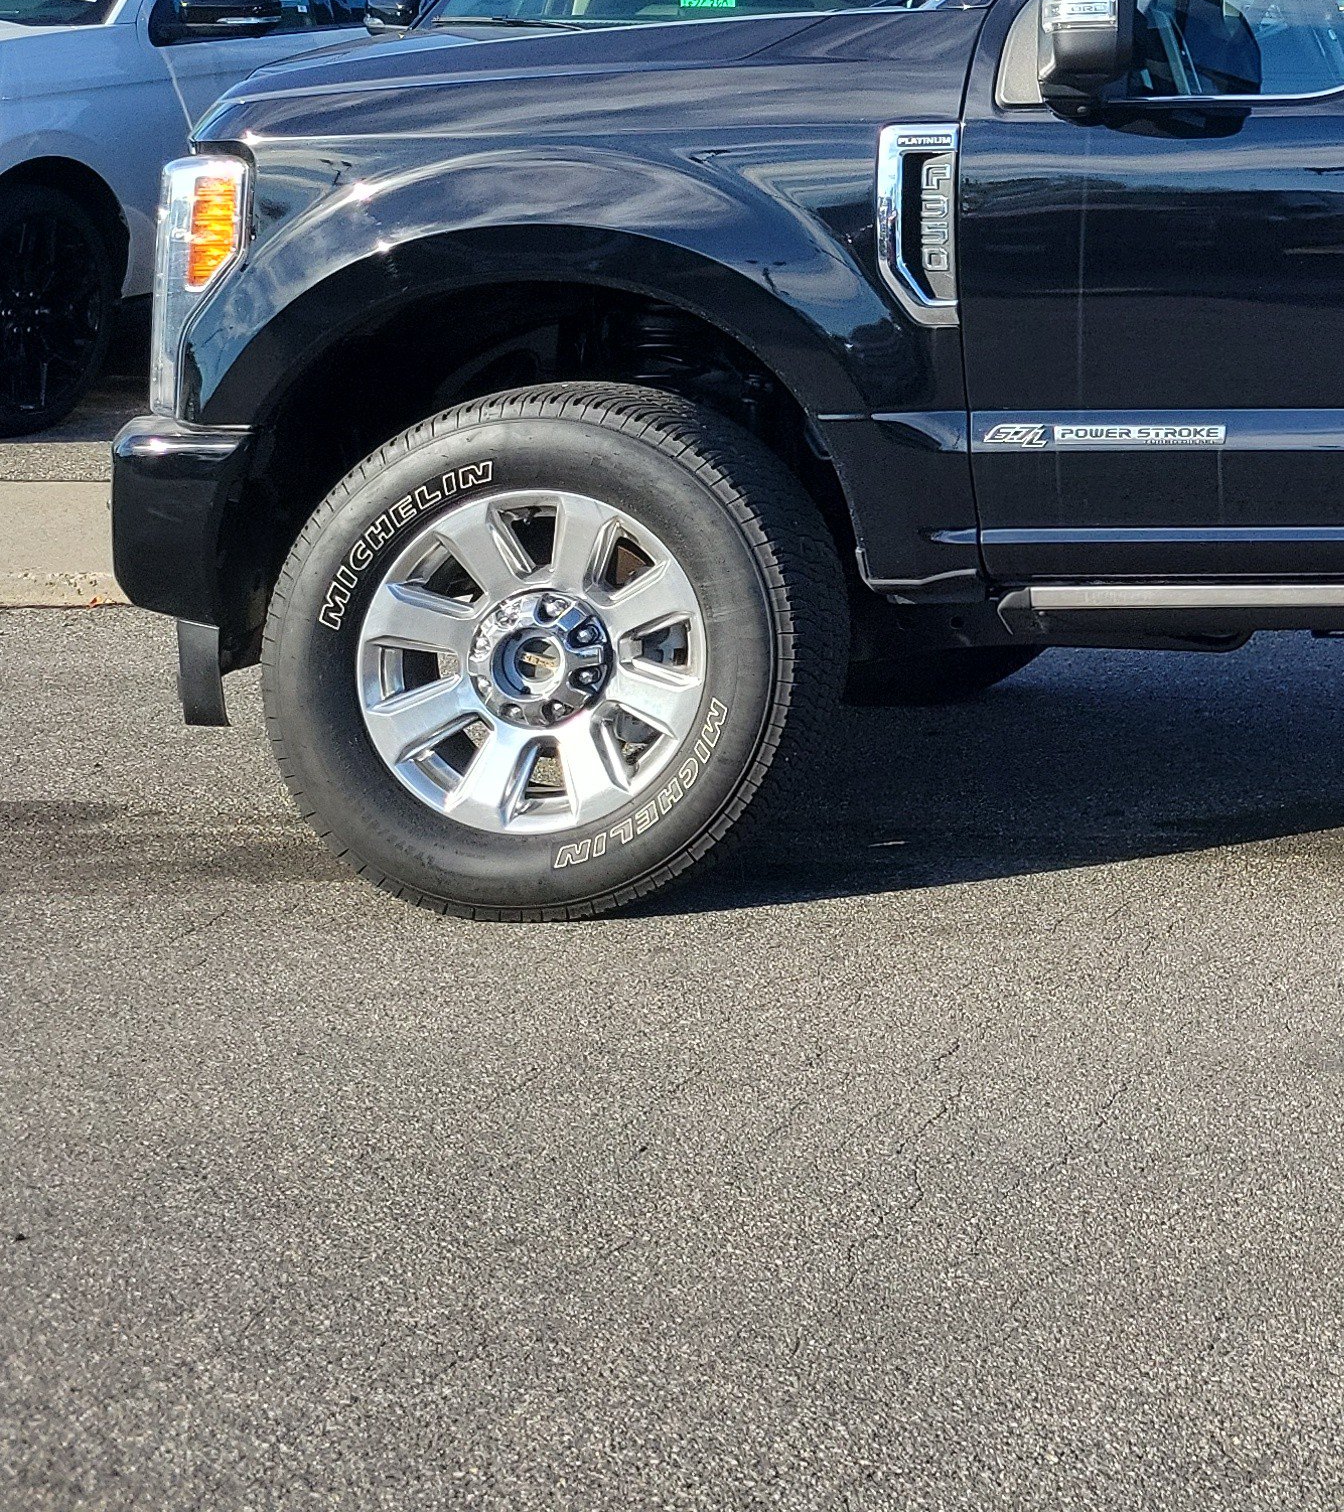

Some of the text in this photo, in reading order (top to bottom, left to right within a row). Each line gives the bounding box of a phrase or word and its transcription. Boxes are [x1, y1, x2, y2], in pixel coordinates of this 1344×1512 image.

[897, 136, 952, 145] PLATINUM
[1060, 428, 1132, 438] POWER
[1137, 427, 1220, 438] STROKE
[319, 459, 494, 630] MICHELIN
[554, 697, 728, 869] MICHELIN
